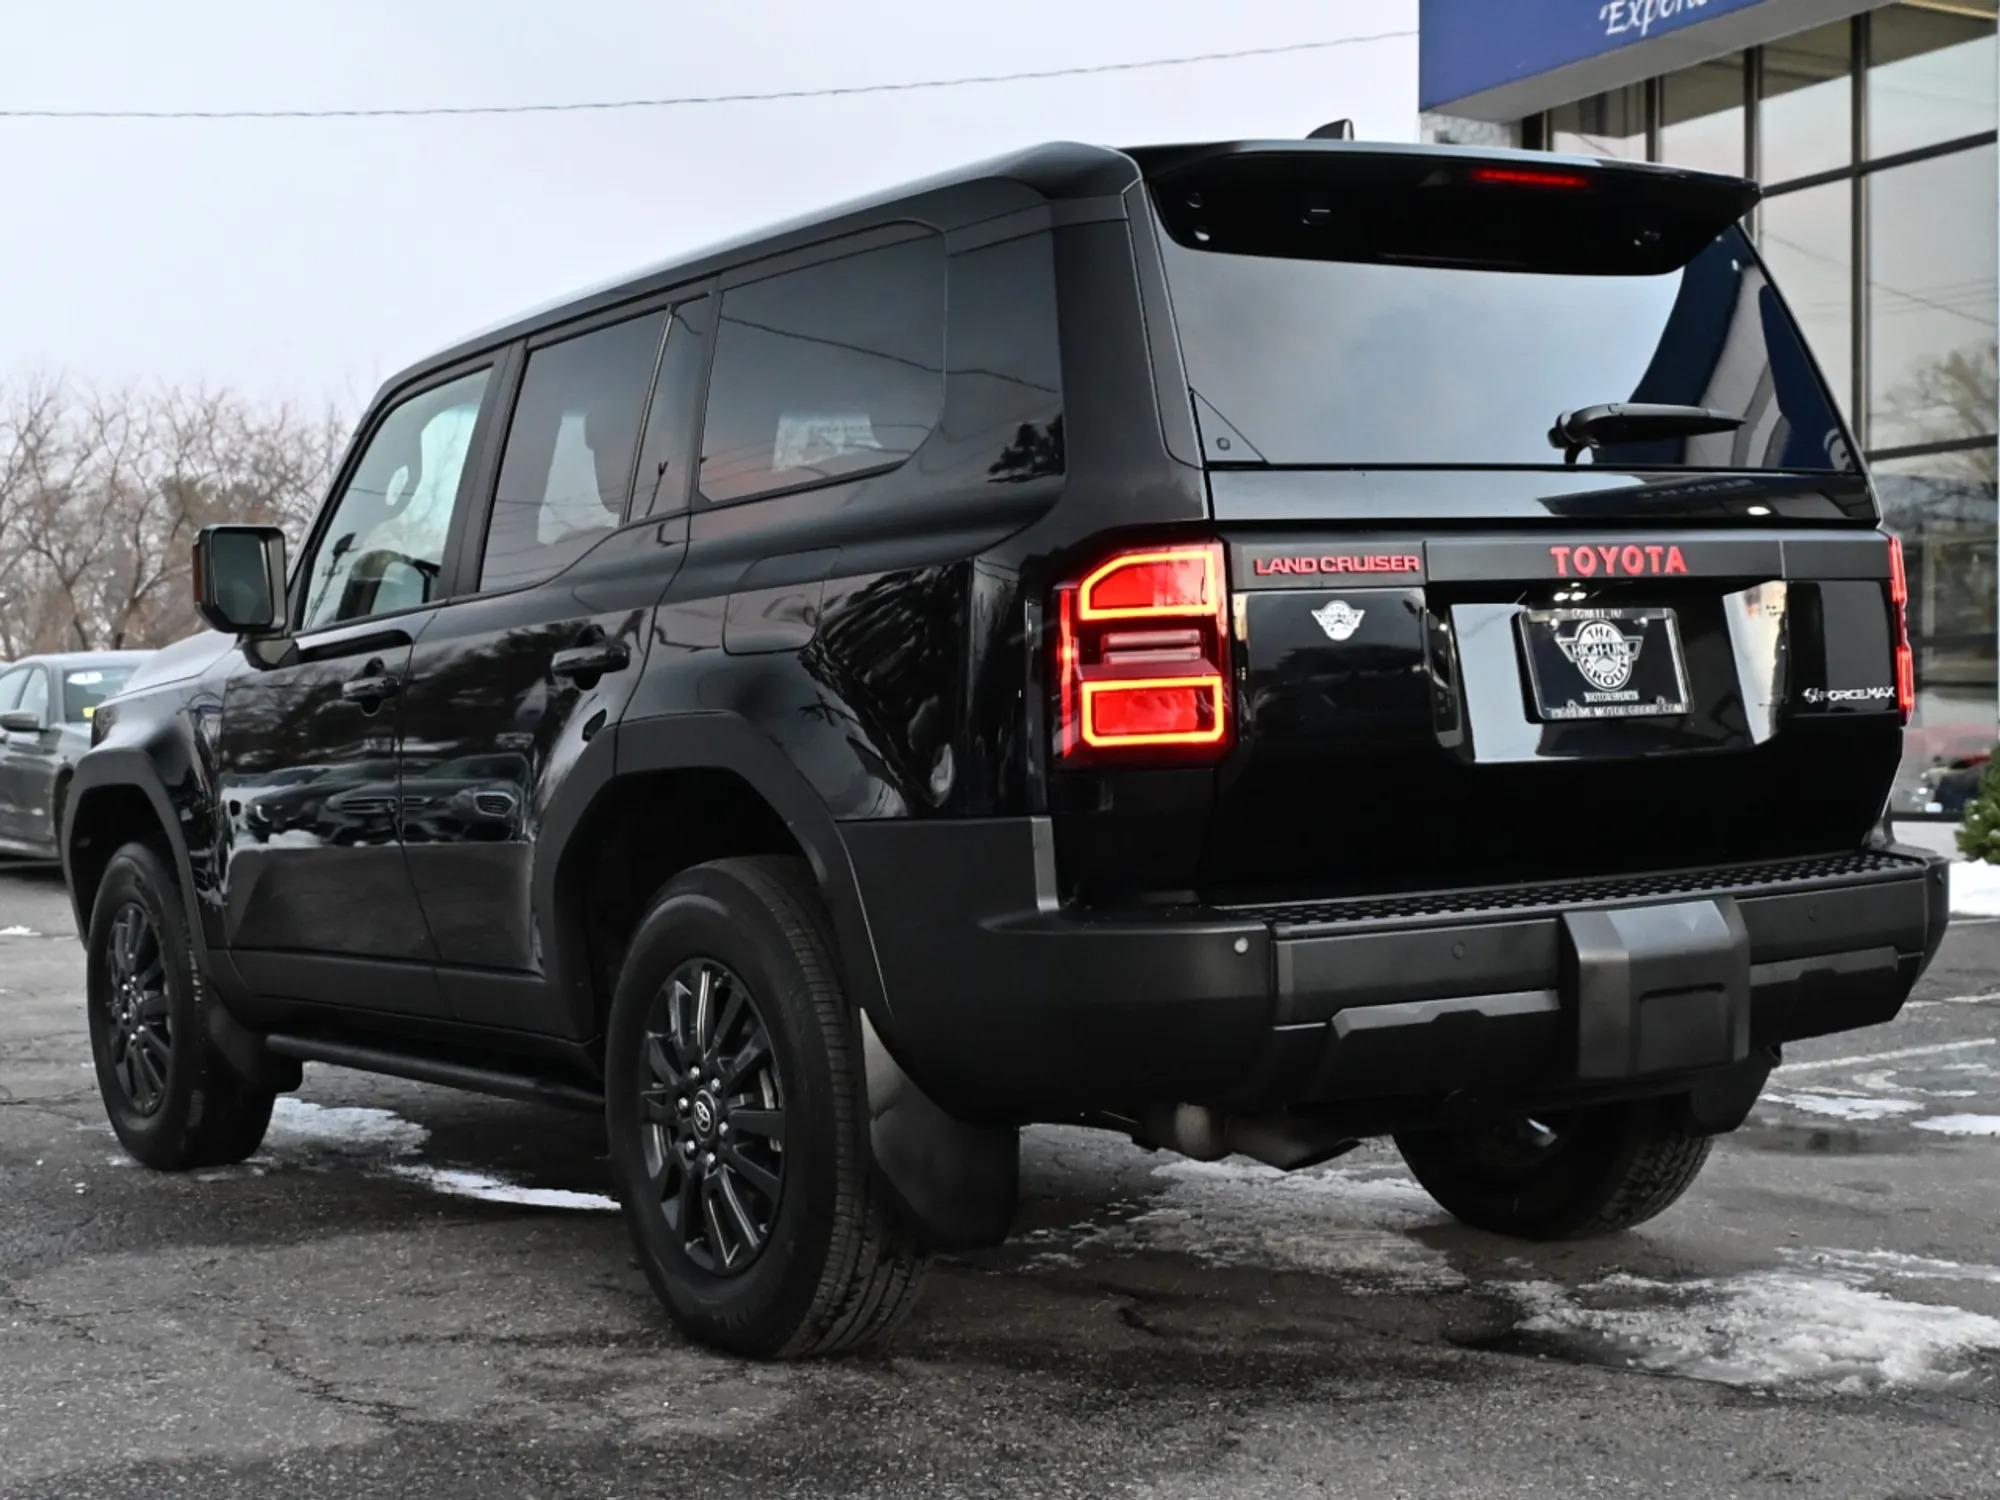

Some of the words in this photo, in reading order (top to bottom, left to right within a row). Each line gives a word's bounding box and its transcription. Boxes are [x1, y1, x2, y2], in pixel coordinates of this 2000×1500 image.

[1254, 556, 1318, 576] LAND
[1320, 554, 1421, 574] CRUISER
[1549, 544, 1688, 577] TOYOTA
